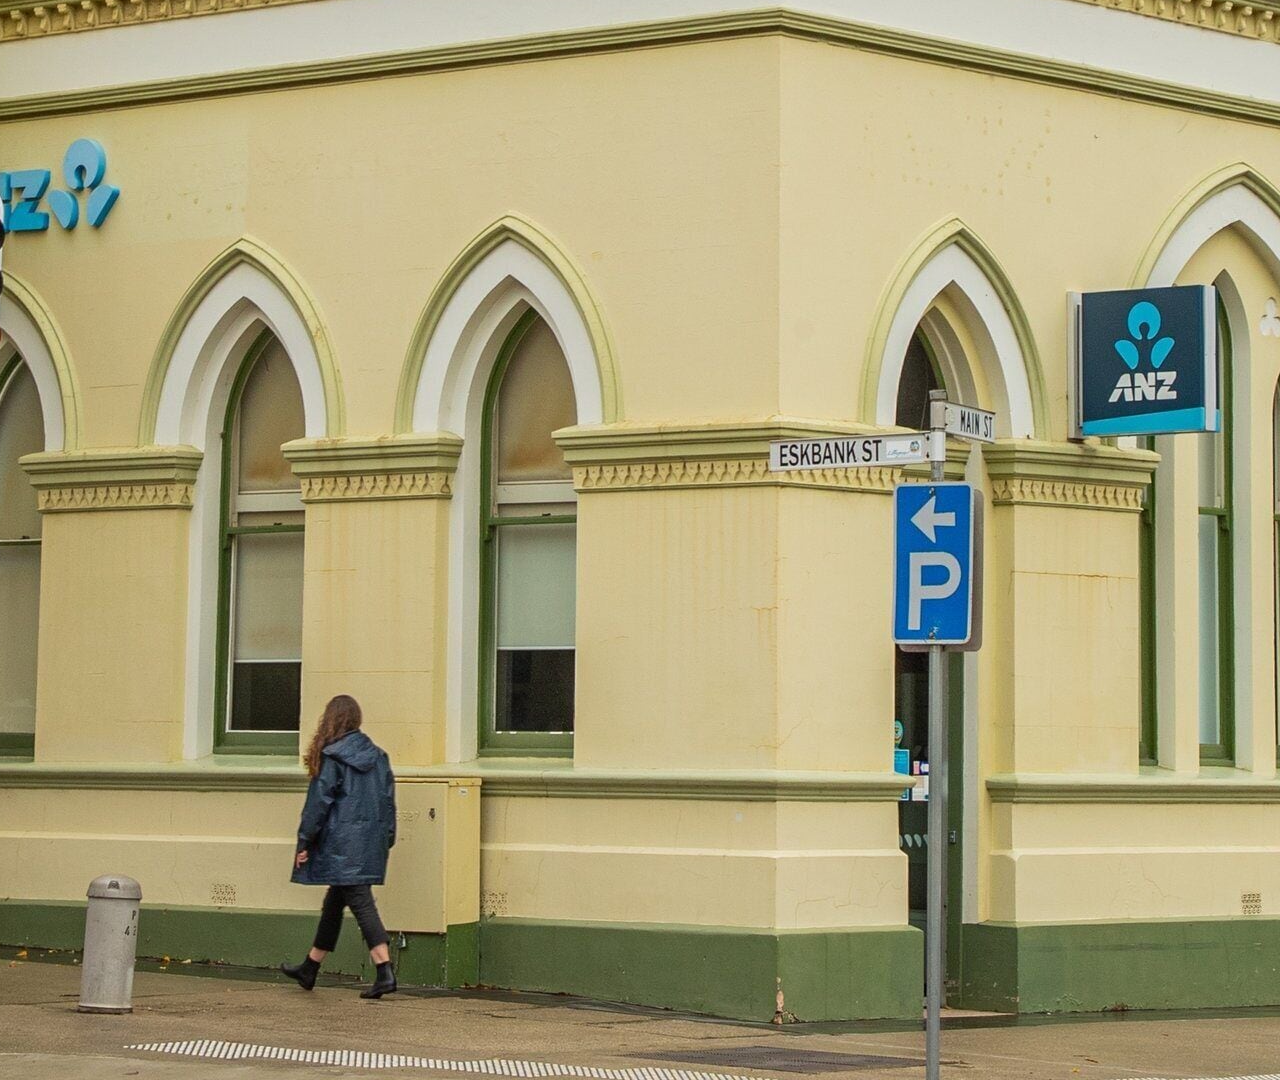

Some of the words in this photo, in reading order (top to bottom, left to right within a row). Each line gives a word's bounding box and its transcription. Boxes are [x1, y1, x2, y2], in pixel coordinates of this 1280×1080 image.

[1108, 371, 1177, 403] ANZ
[960, 409, 980, 435] MAIN
[984, 415, 993, 439] ST
[779, 441, 857, 467] ESKBANK
[862, 439, 882, 462] ST
[907, 551, 962, 631] P
